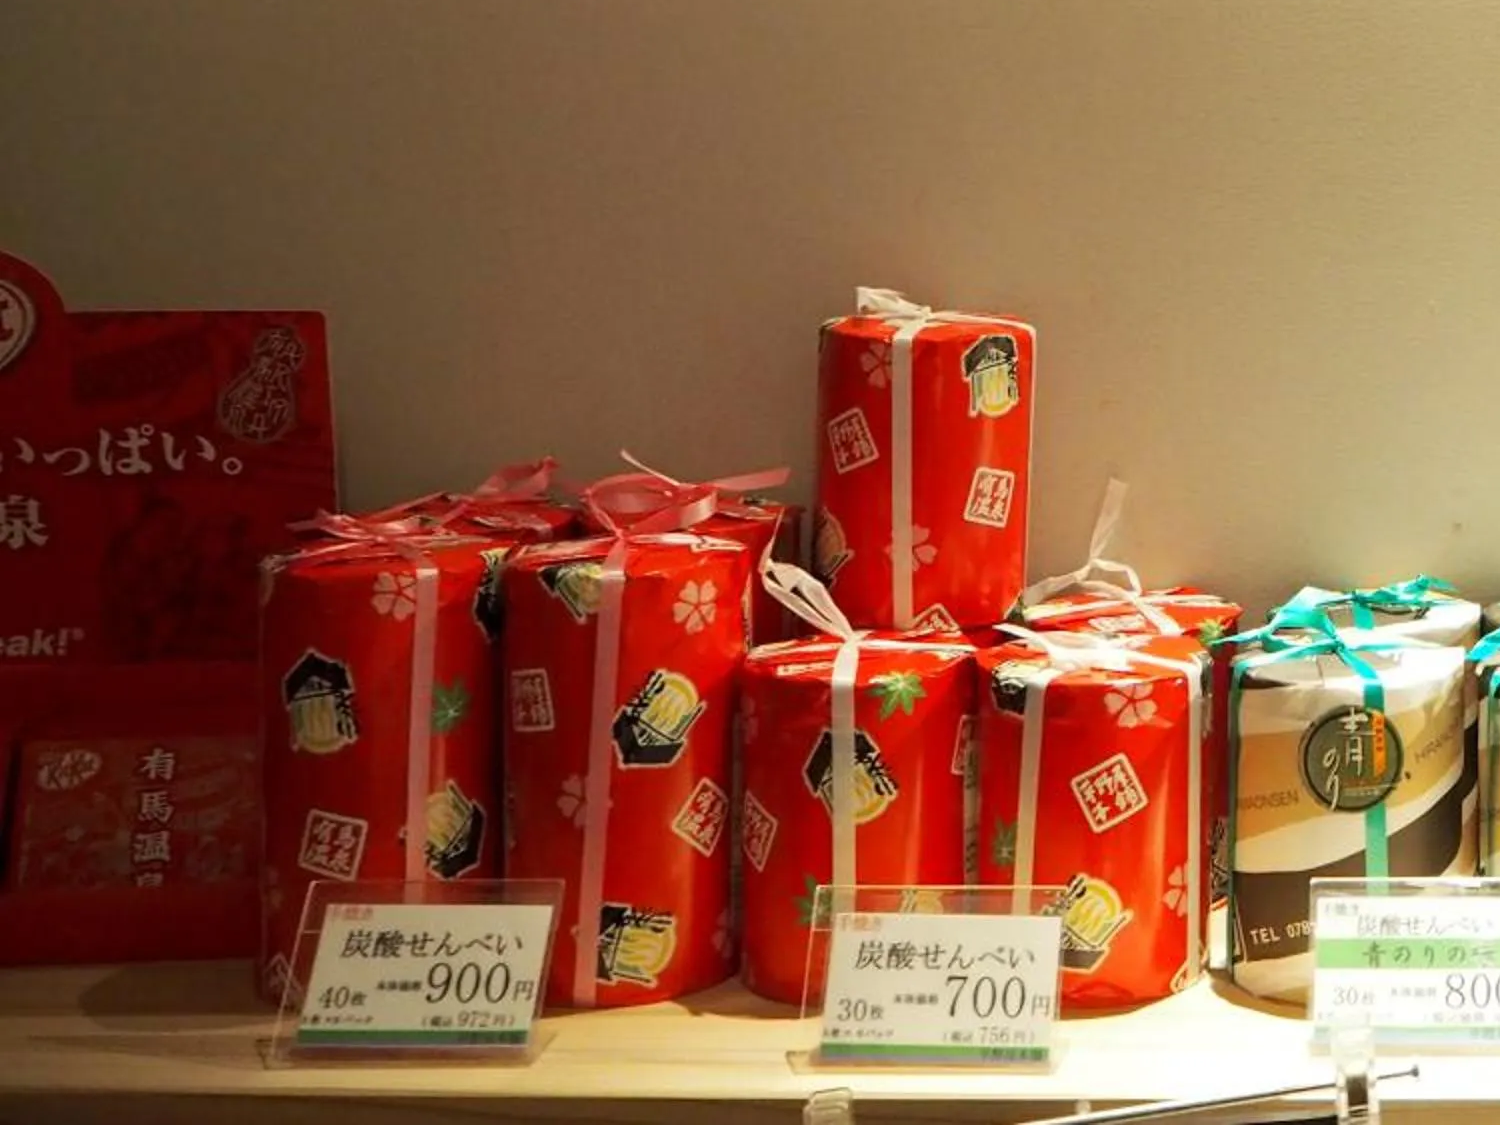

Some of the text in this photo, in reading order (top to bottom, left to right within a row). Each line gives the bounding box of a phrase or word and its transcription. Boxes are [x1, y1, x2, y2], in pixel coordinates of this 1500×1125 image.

[340, 930, 524, 959] 炭酸せんべい
[1249, 925, 1281, 947] TEL
[854, 938, 1036, 971] 炭酸せんべい
